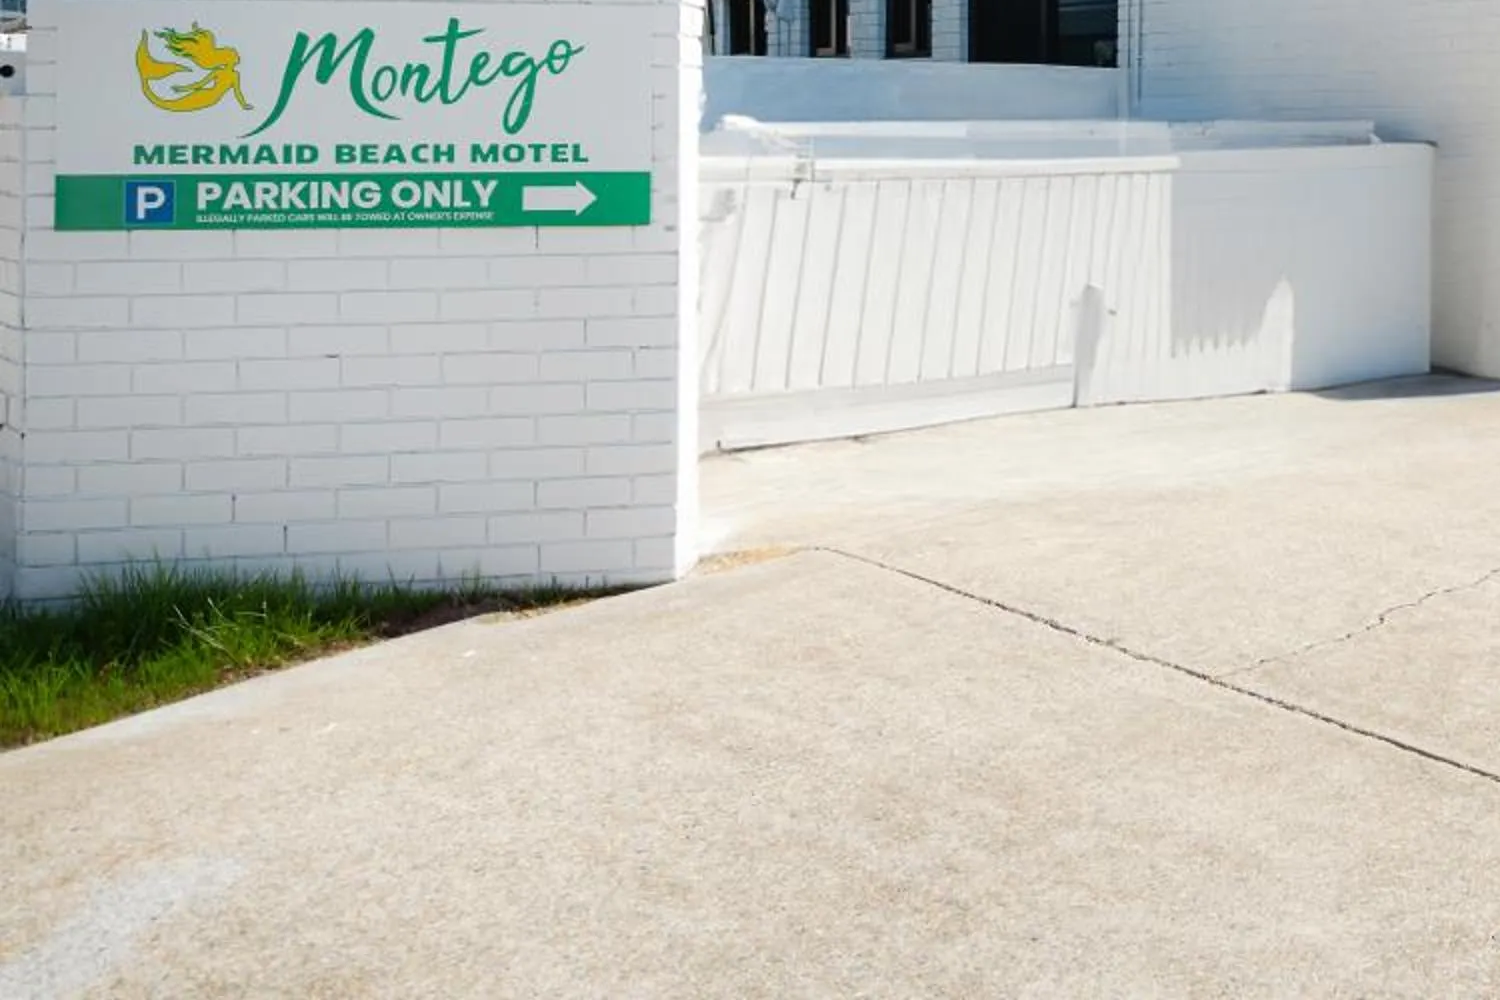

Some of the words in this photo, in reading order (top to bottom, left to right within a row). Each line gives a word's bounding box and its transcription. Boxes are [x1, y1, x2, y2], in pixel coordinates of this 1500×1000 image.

[239, 18, 584, 138] Montego
[133, 143, 320, 165] MERMAID
[335, 144, 456, 165] BEACH
[470, 143, 589, 163] MOTEL
[137, 186, 165, 219] P
[197, 181, 381, 210] PARKING
[391, 179, 498, 209] ONLY
[247, 213, 286, 223] PARKED
[393, 212, 405, 221] AT
